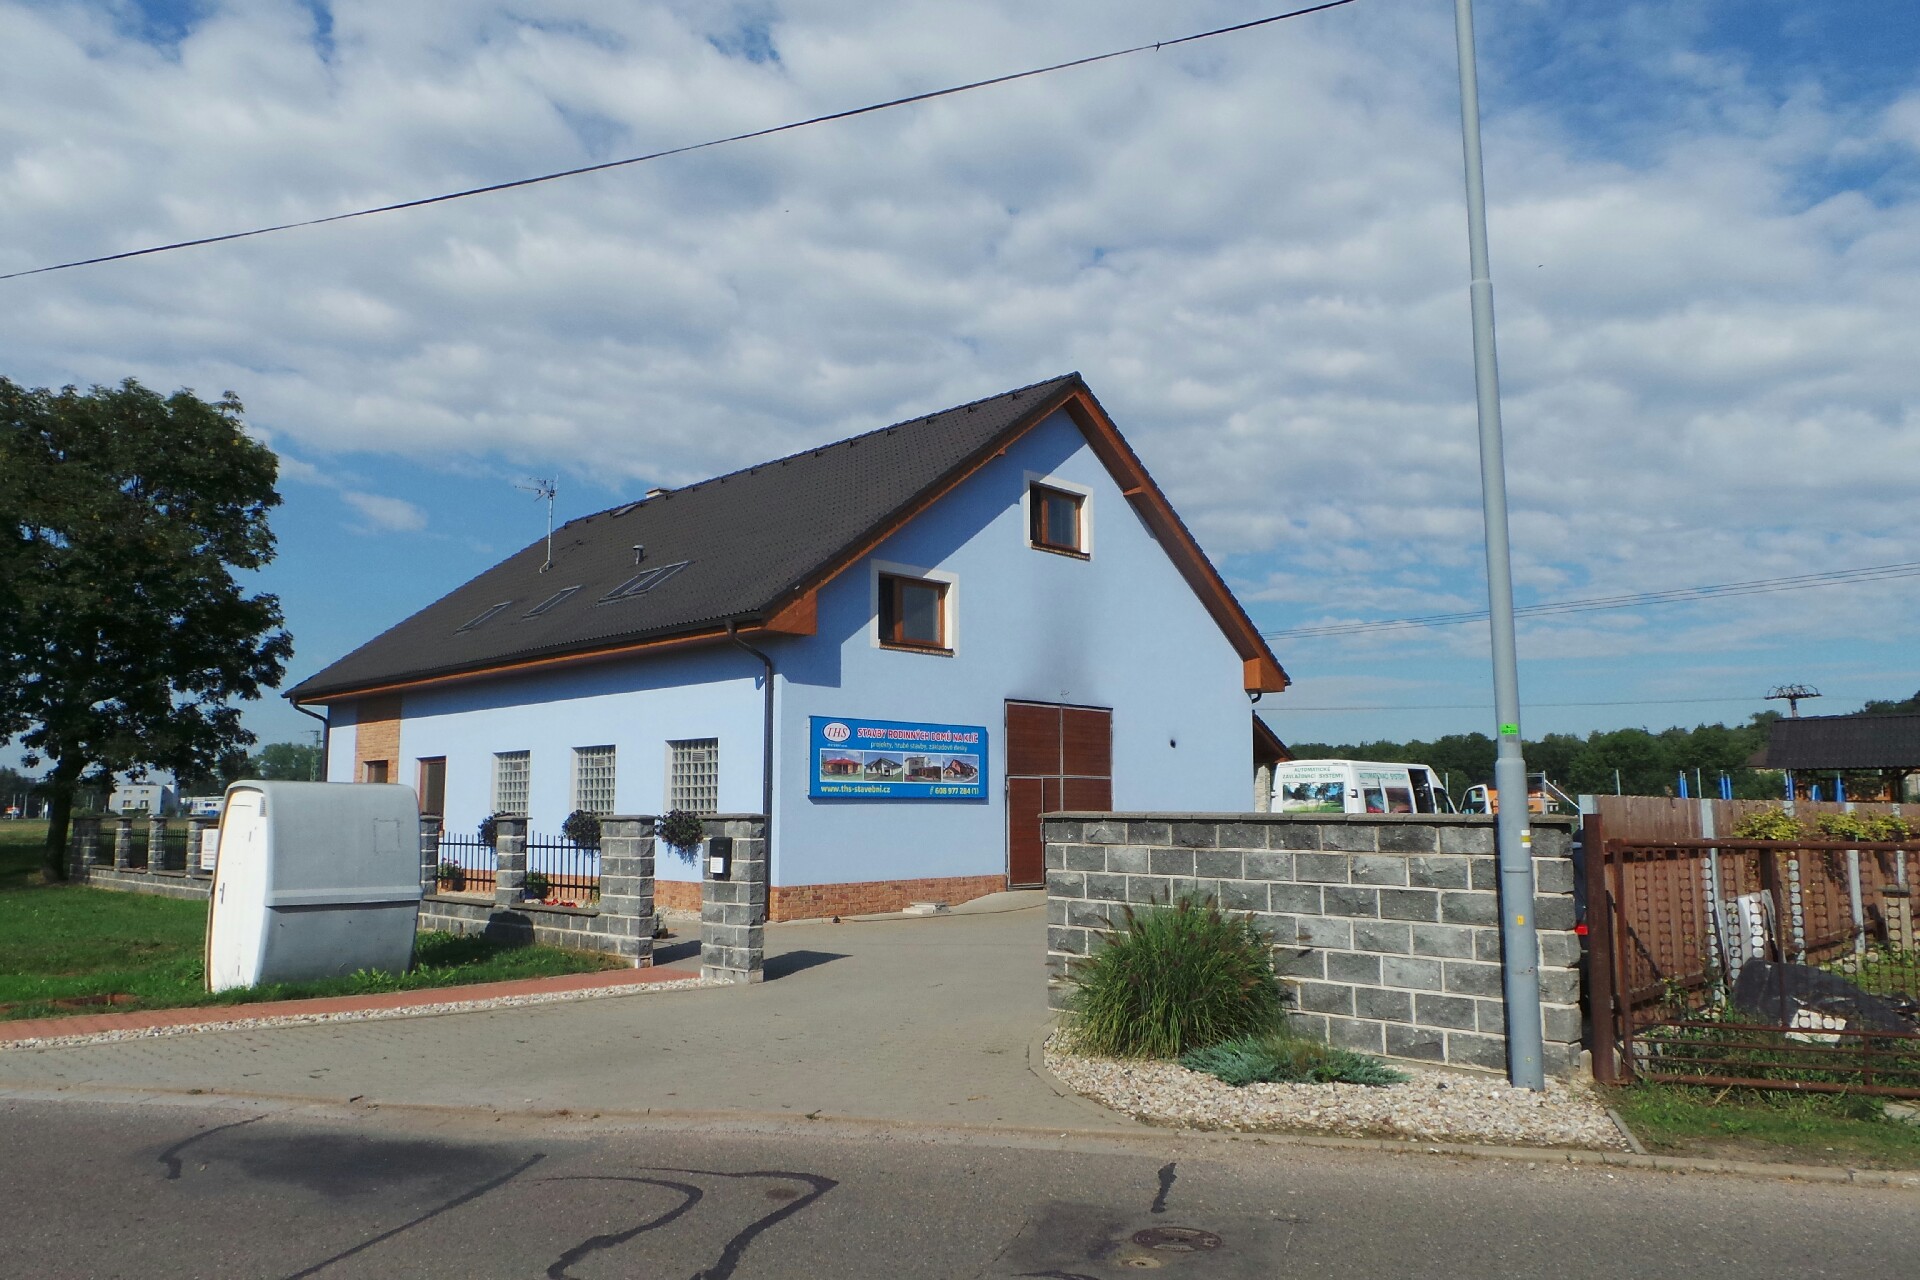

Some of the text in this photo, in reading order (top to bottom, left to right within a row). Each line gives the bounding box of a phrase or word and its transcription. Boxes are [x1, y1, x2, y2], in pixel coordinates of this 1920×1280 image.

[828, 727, 848, 738] THS
[857, 728, 886, 739] STAVBY
[888, 729, 930, 742] RODINNÝCH
[931, 730, 952, 743] DOMŮ
[953, 733, 963, 743] NA
[820, 784, 891, 794] www.ths-stavebni.cz
[947, 787, 959, 795] 977
